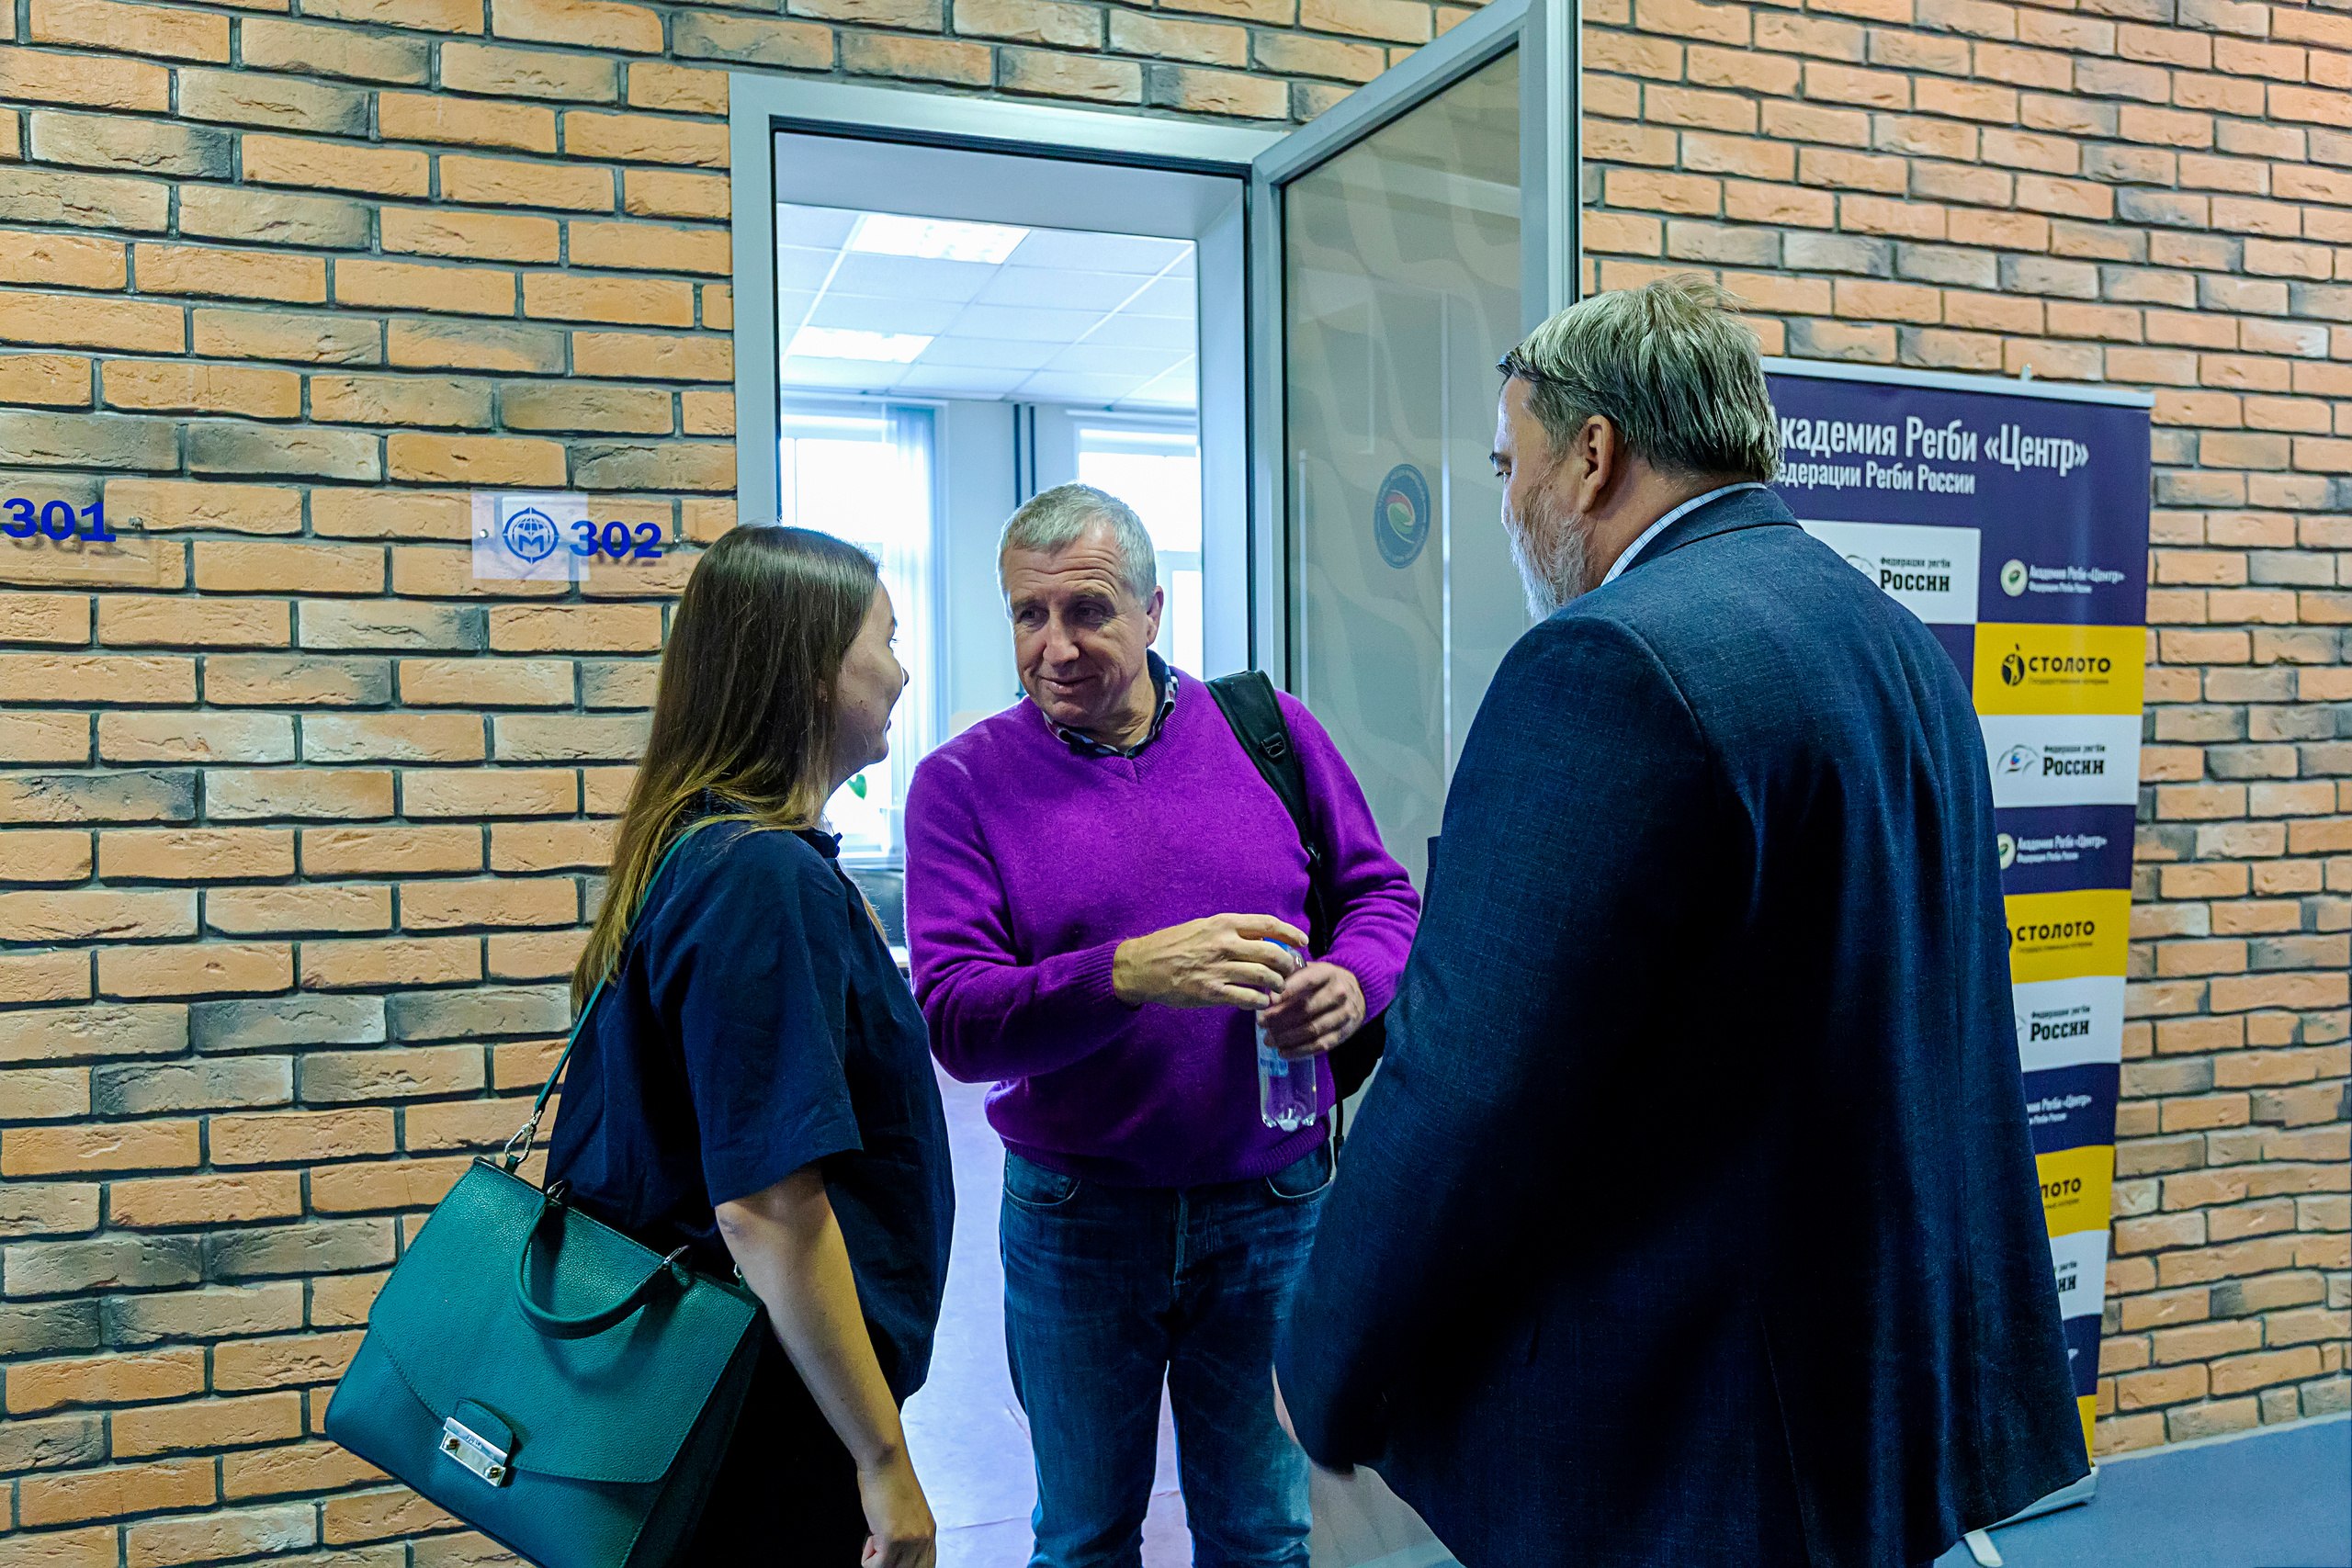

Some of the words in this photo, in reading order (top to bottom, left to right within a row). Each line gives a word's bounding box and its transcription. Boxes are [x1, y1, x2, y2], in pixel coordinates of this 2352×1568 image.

[1781, 416, 1897, 459] кадемия
[1905, 415, 1978, 462] Регби
[1984, 423, 2089, 478] «Центр»
[1778, 461, 1861, 491] едерации
[1865, 460, 1914, 491] Регби
[1917, 463, 1975, 494] России
[2, 497, 117, 542] 301
[569, 520, 662, 558] 302
[2029, 656, 2112, 673] СТОЛОТО
[2017, 920, 2095, 942] СТОЛОТО
[2041, 1177, 2082, 1199] ЛОТО
